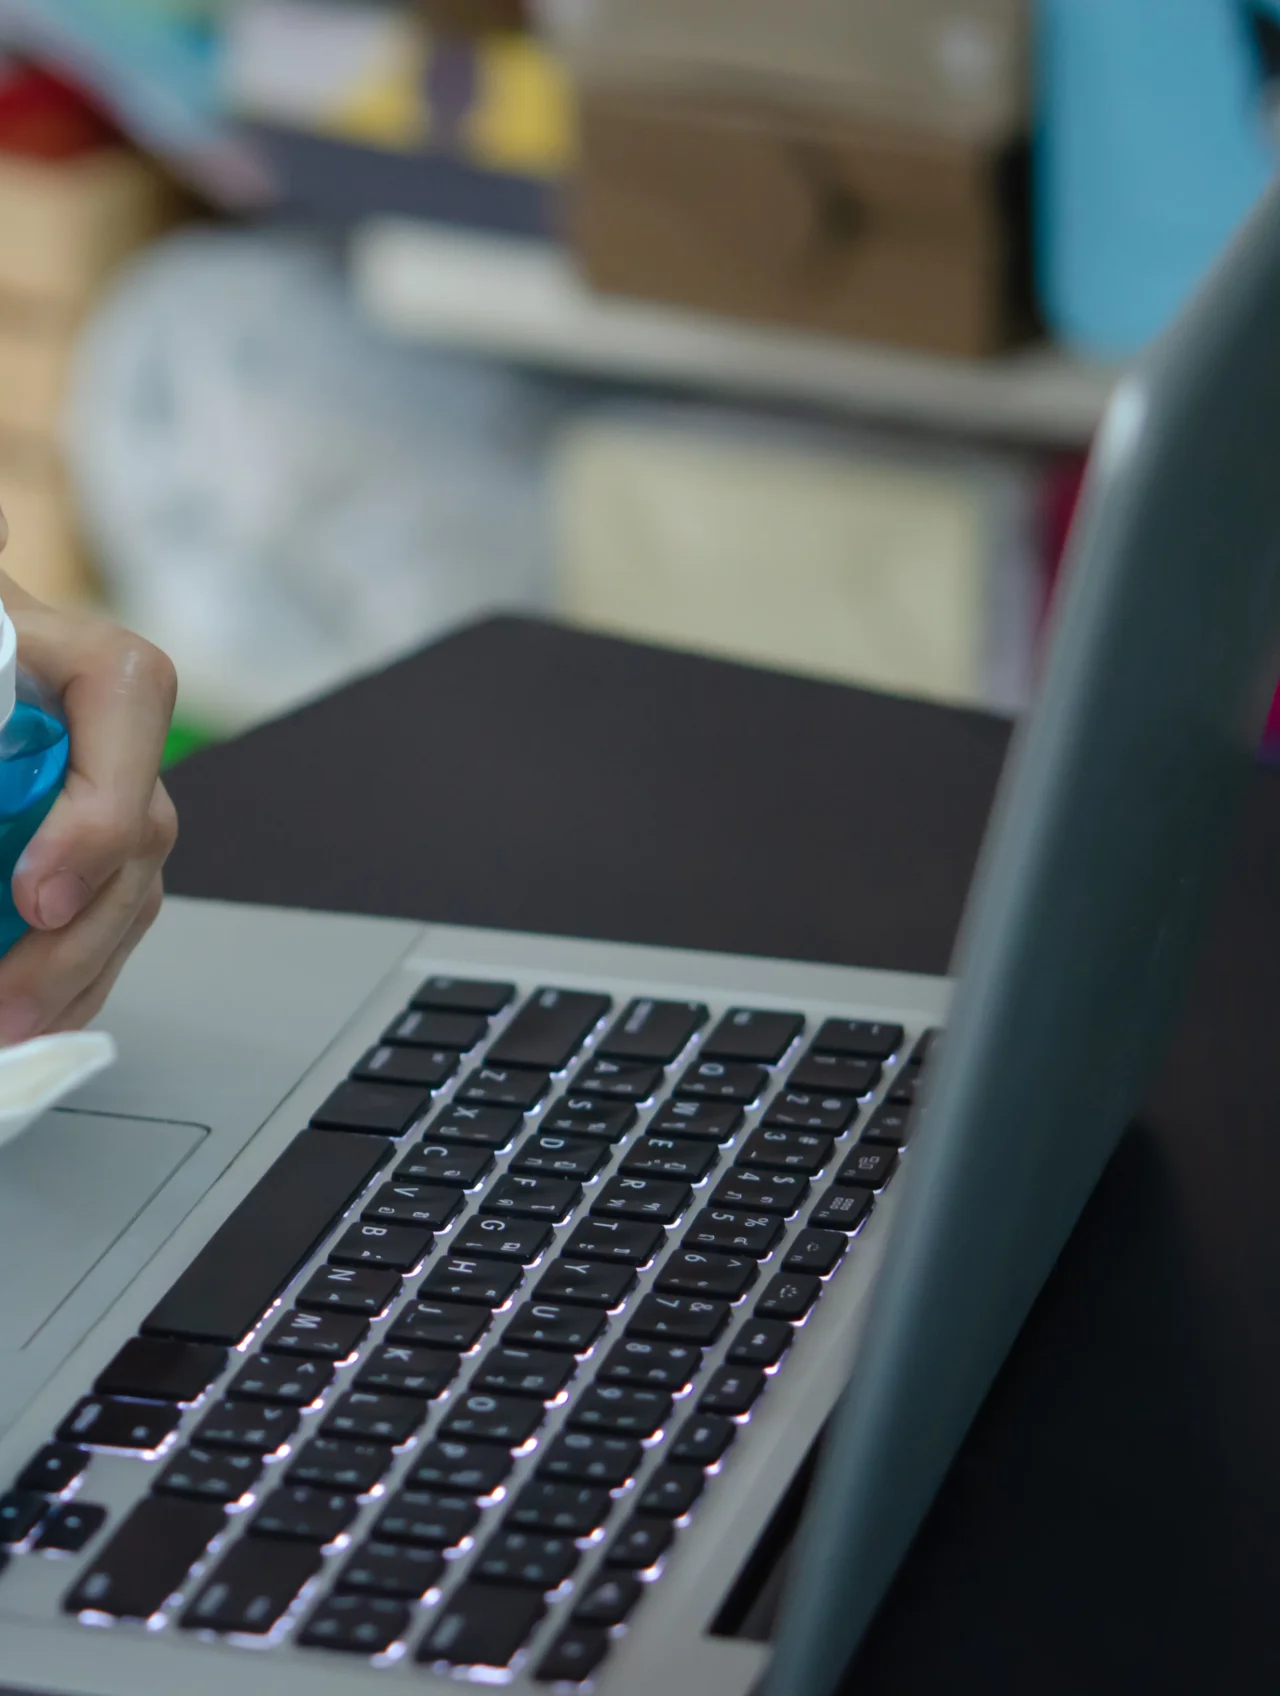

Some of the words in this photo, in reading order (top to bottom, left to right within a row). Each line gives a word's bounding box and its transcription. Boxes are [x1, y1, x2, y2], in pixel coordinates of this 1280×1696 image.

[594, 1060, 619, 1073] A
[479, 1069, 507, 1082] Z
[567, 1099, 593, 1110] S
[671, 1102, 700, 1116] W
[452, 1106, 479, 1119] X
[763, 1131, 787, 1141] 3
[539, 1137, 565, 1149] D
[648, 1138, 674, 1149] E
[423, 1146, 449, 1157] C
[737, 1171, 761, 1181] 4
[513, 1177, 537, 1187] F
[619, 1178, 647, 1189] R
[393, 1187, 420, 1198] V
[711, 1211, 735, 1222] 5
[480, 1219, 506, 1231] G
[592, 1222, 619, 1231] T
[744, 1217, 769, 1228] %
[361, 1226, 388, 1236] B
[684, 1253, 707, 1263] 6
[447, 1259, 477, 1273] H
[563, 1264, 591, 1274] Y
[327, 1268, 357, 1282] N
[655, 1297, 680, 1308] 7
[688, 1301, 714, 1312] &
[417, 1303, 442, 1314] J
[531, 1305, 560, 1319] U
[290, 1313, 322, 1329] M
[625, 1342, 652, 1353] 8
[383, 1347, 412, 1361] K
